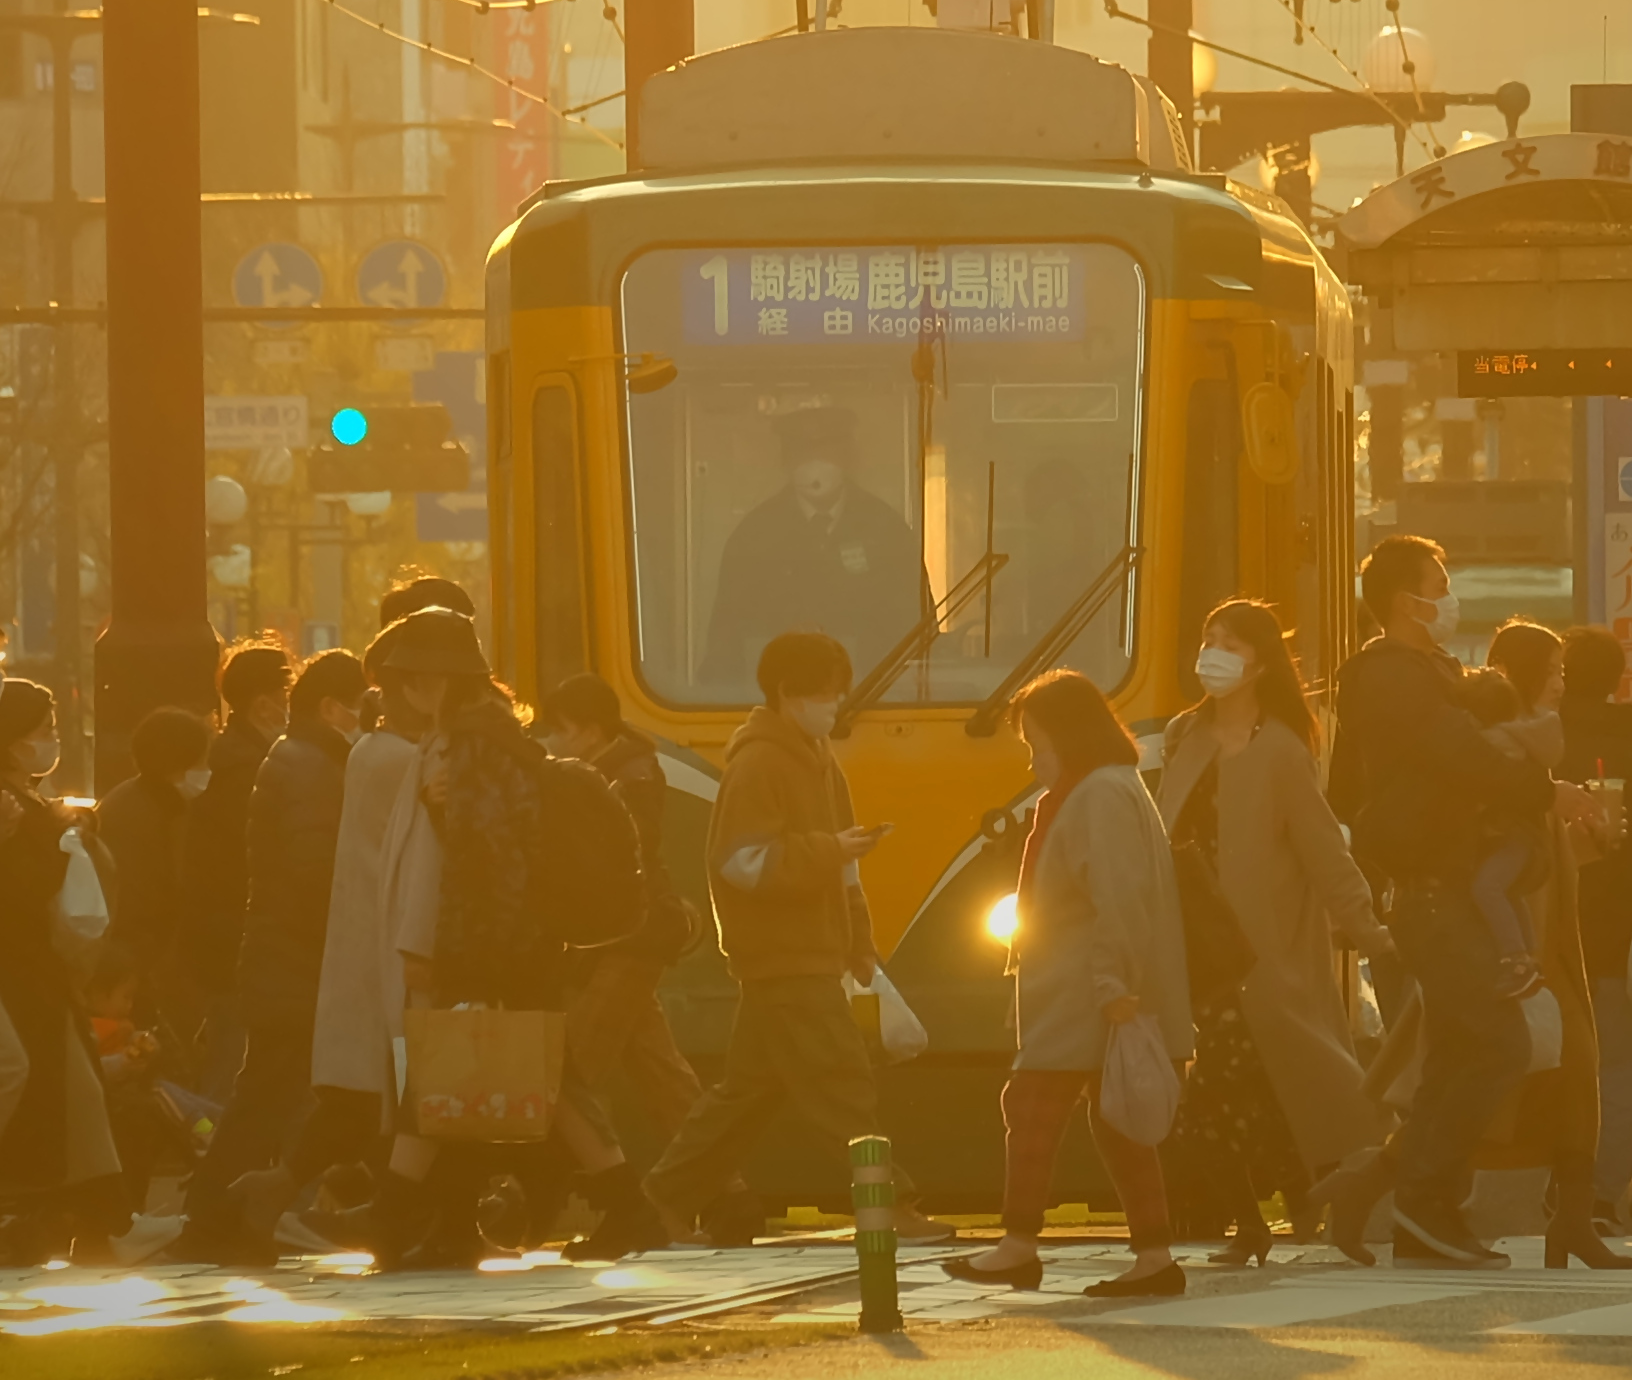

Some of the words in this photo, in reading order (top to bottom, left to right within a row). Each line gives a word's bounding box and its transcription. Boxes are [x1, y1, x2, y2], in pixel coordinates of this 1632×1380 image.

[699, 254, 729, 337] 1
[750, 252, 860, 302] 騎射場
[867, 251, 1071, 310] 鹿児島駅前
[757, 306, 854, 336] 経由
[867, 312, 1071, 339] Kagoshimaeki-mae
[1474, 353, 1529, 376] 当電停
